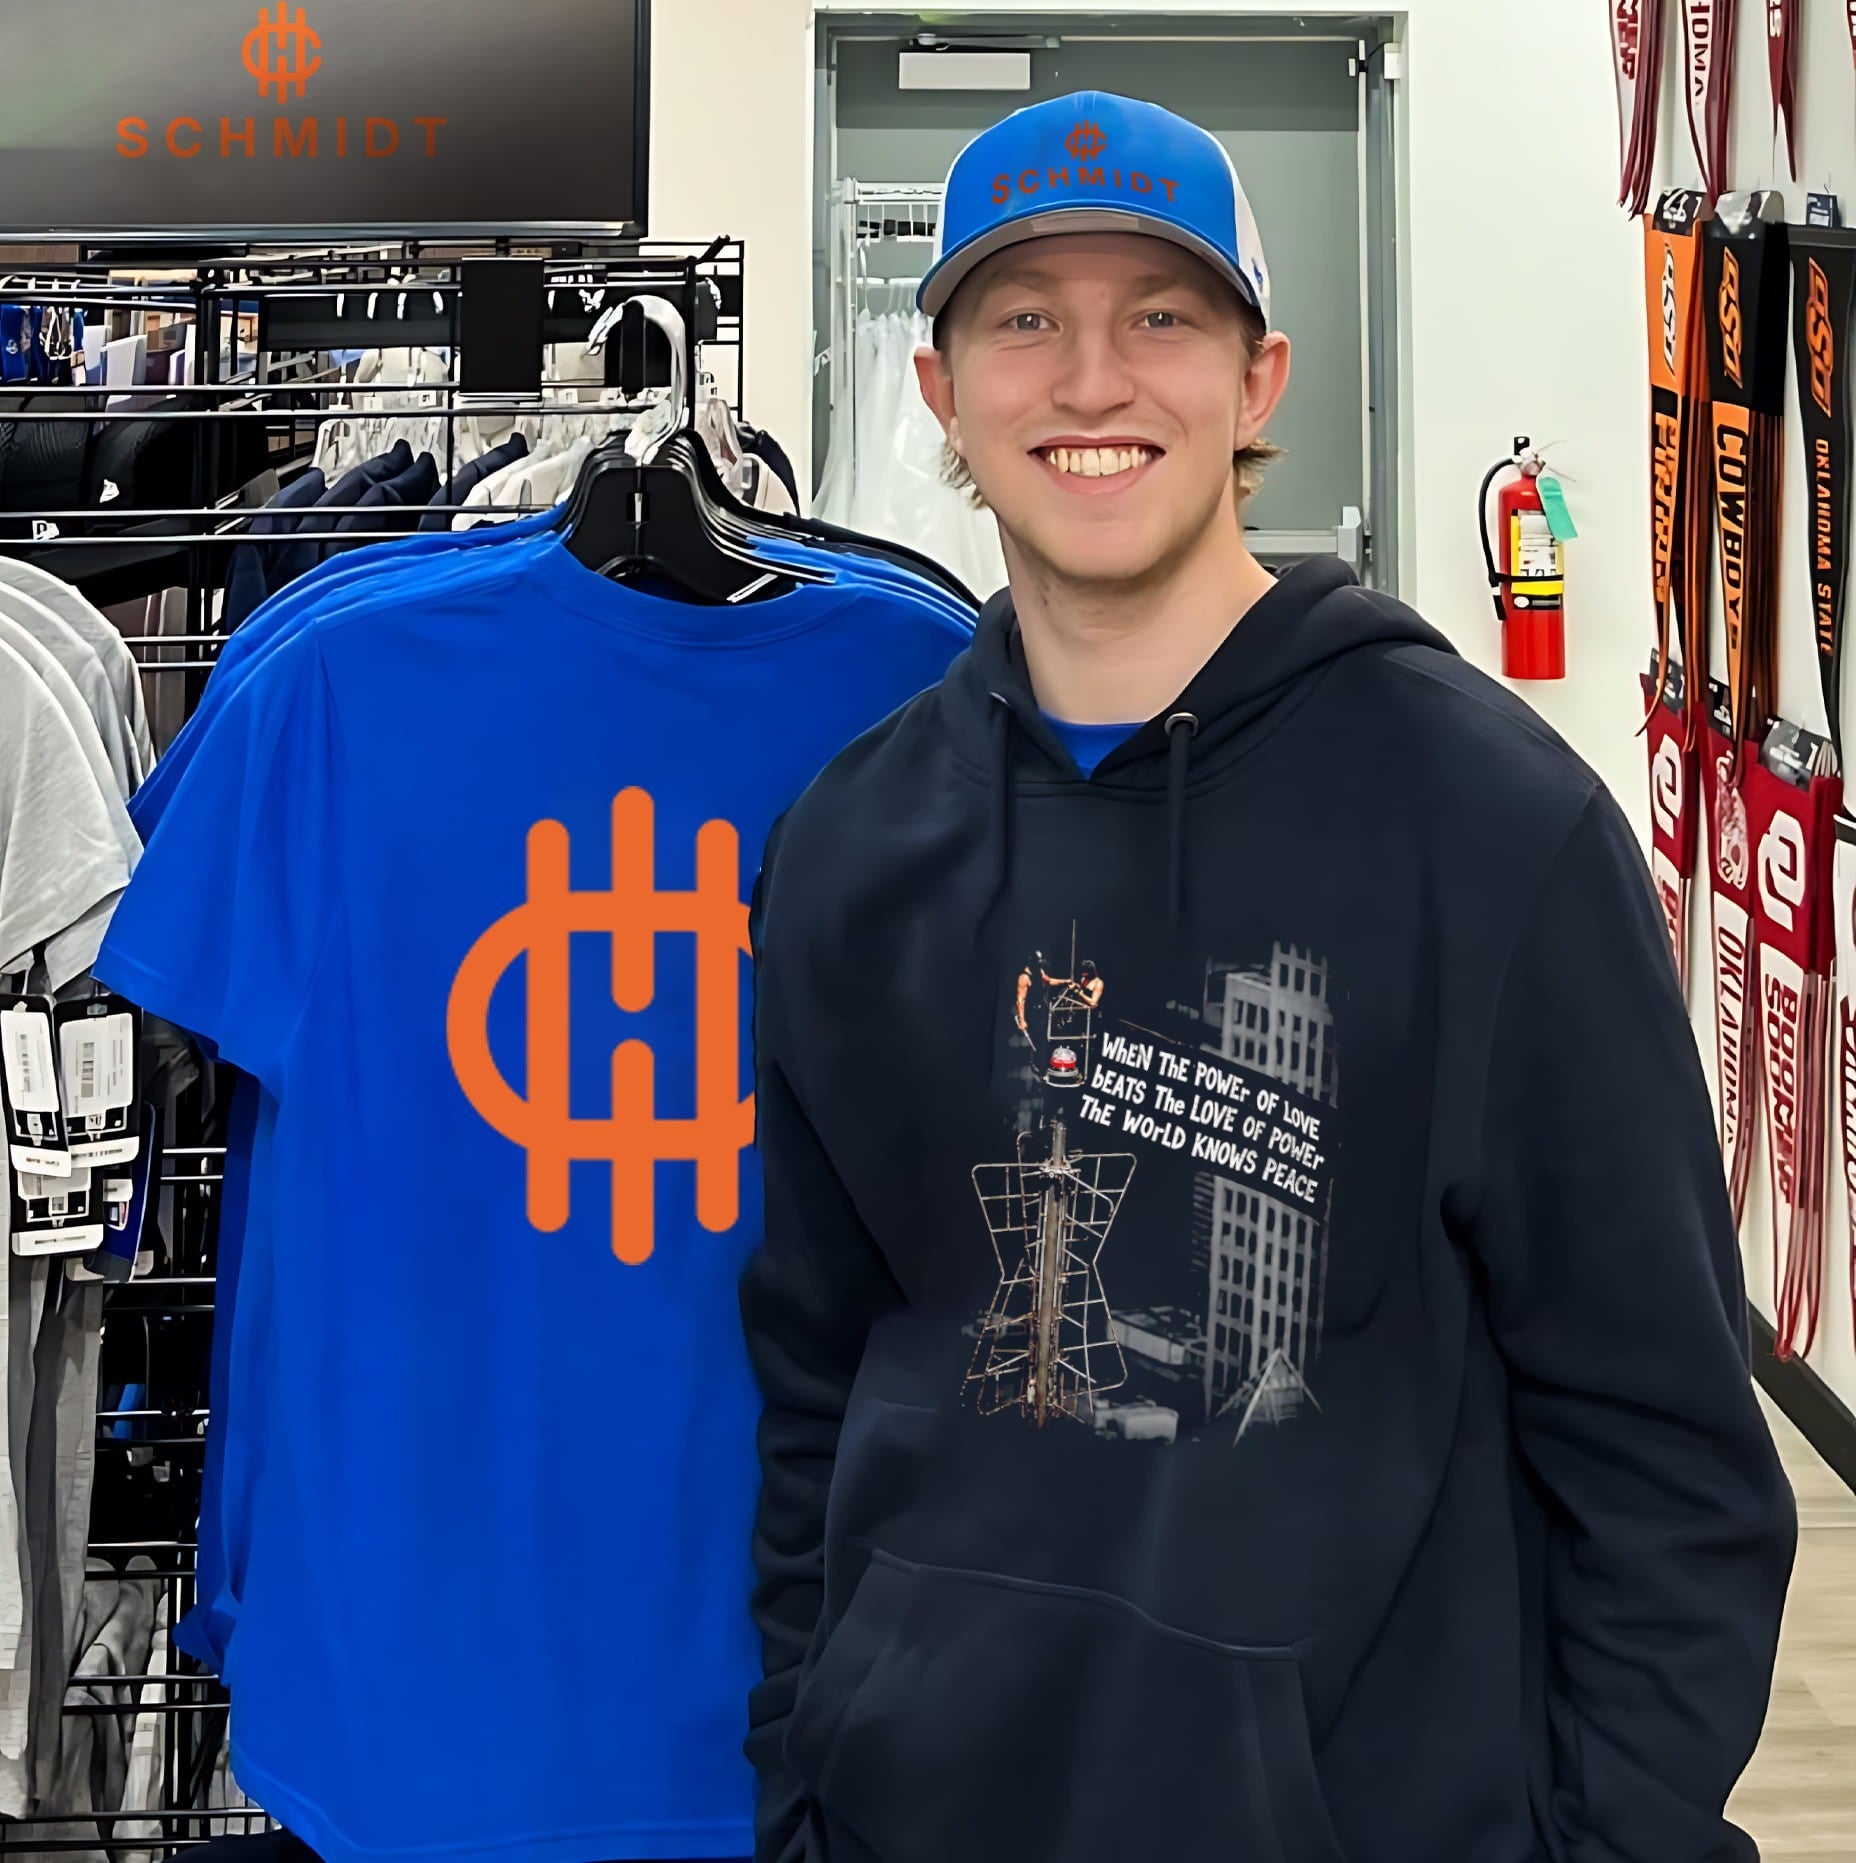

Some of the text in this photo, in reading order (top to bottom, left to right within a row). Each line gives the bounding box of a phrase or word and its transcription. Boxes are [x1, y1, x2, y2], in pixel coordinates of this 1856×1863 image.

[115, 117, 447, 158] SCHMIDT
[992, 167, 1179, 204] SCHMIDT
[1815, 439, 1831, 570] OKLAHOMA
[1718, 926, 1745, 1144] OKLAHOMA
[1190, 1094, 1238, 1133] LOVE
[1242, 1116, 1266, 1142] OF
[1256, 1089, 1280, 1115] OF
[1283, 1100, 1321, 1141] LOVE
[1191, 1132, 1258, 1174] KNOWS
[1262, 1157, 1319, 1203] PEACE
